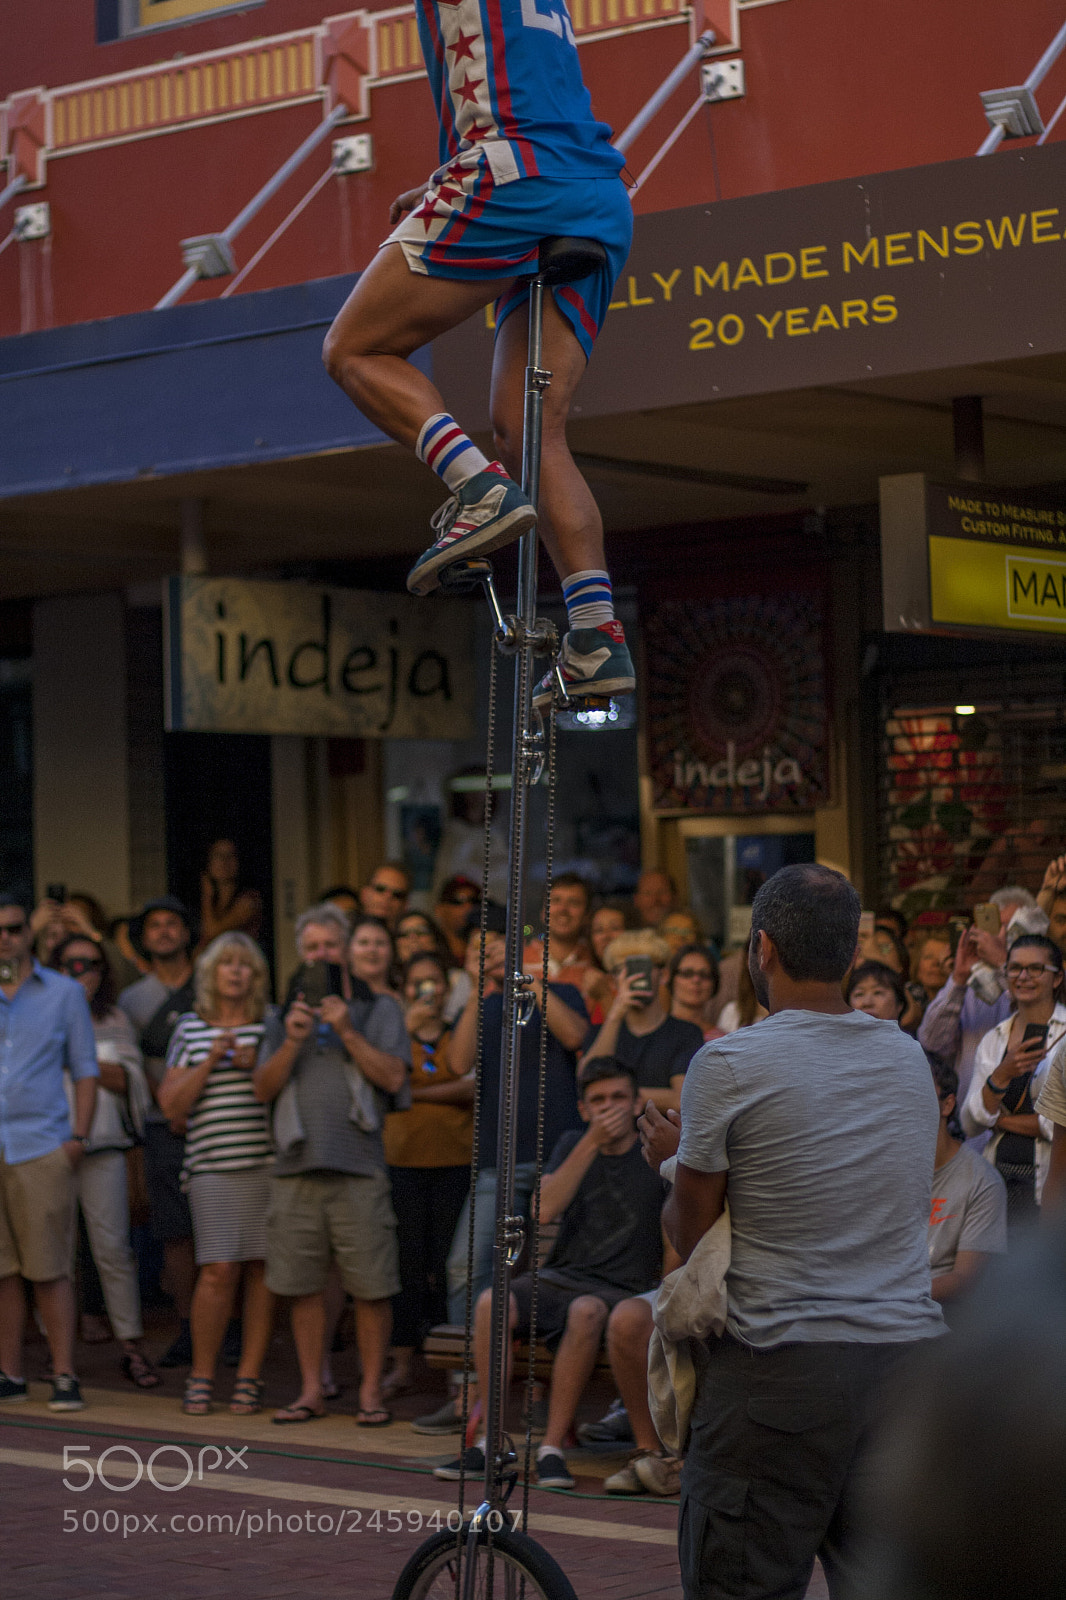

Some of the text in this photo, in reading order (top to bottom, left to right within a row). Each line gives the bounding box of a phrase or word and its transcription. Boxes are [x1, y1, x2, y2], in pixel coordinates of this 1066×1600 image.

[694, 207, 1066, 295] MADE MENSWE
[689, 295, 899, 350] 20 YEARS
[948, 495, 982, 515] MADE
[984, 502, 1000, 518] TO
[1001, 503, 1055, 526] MEASURE
[961, 516, 1010, 537] CUSTOM
[1013, 568, 1066, 609] MA
[216, 594, 452, 731] indeja
[673, 741, 802, 801] indeja
